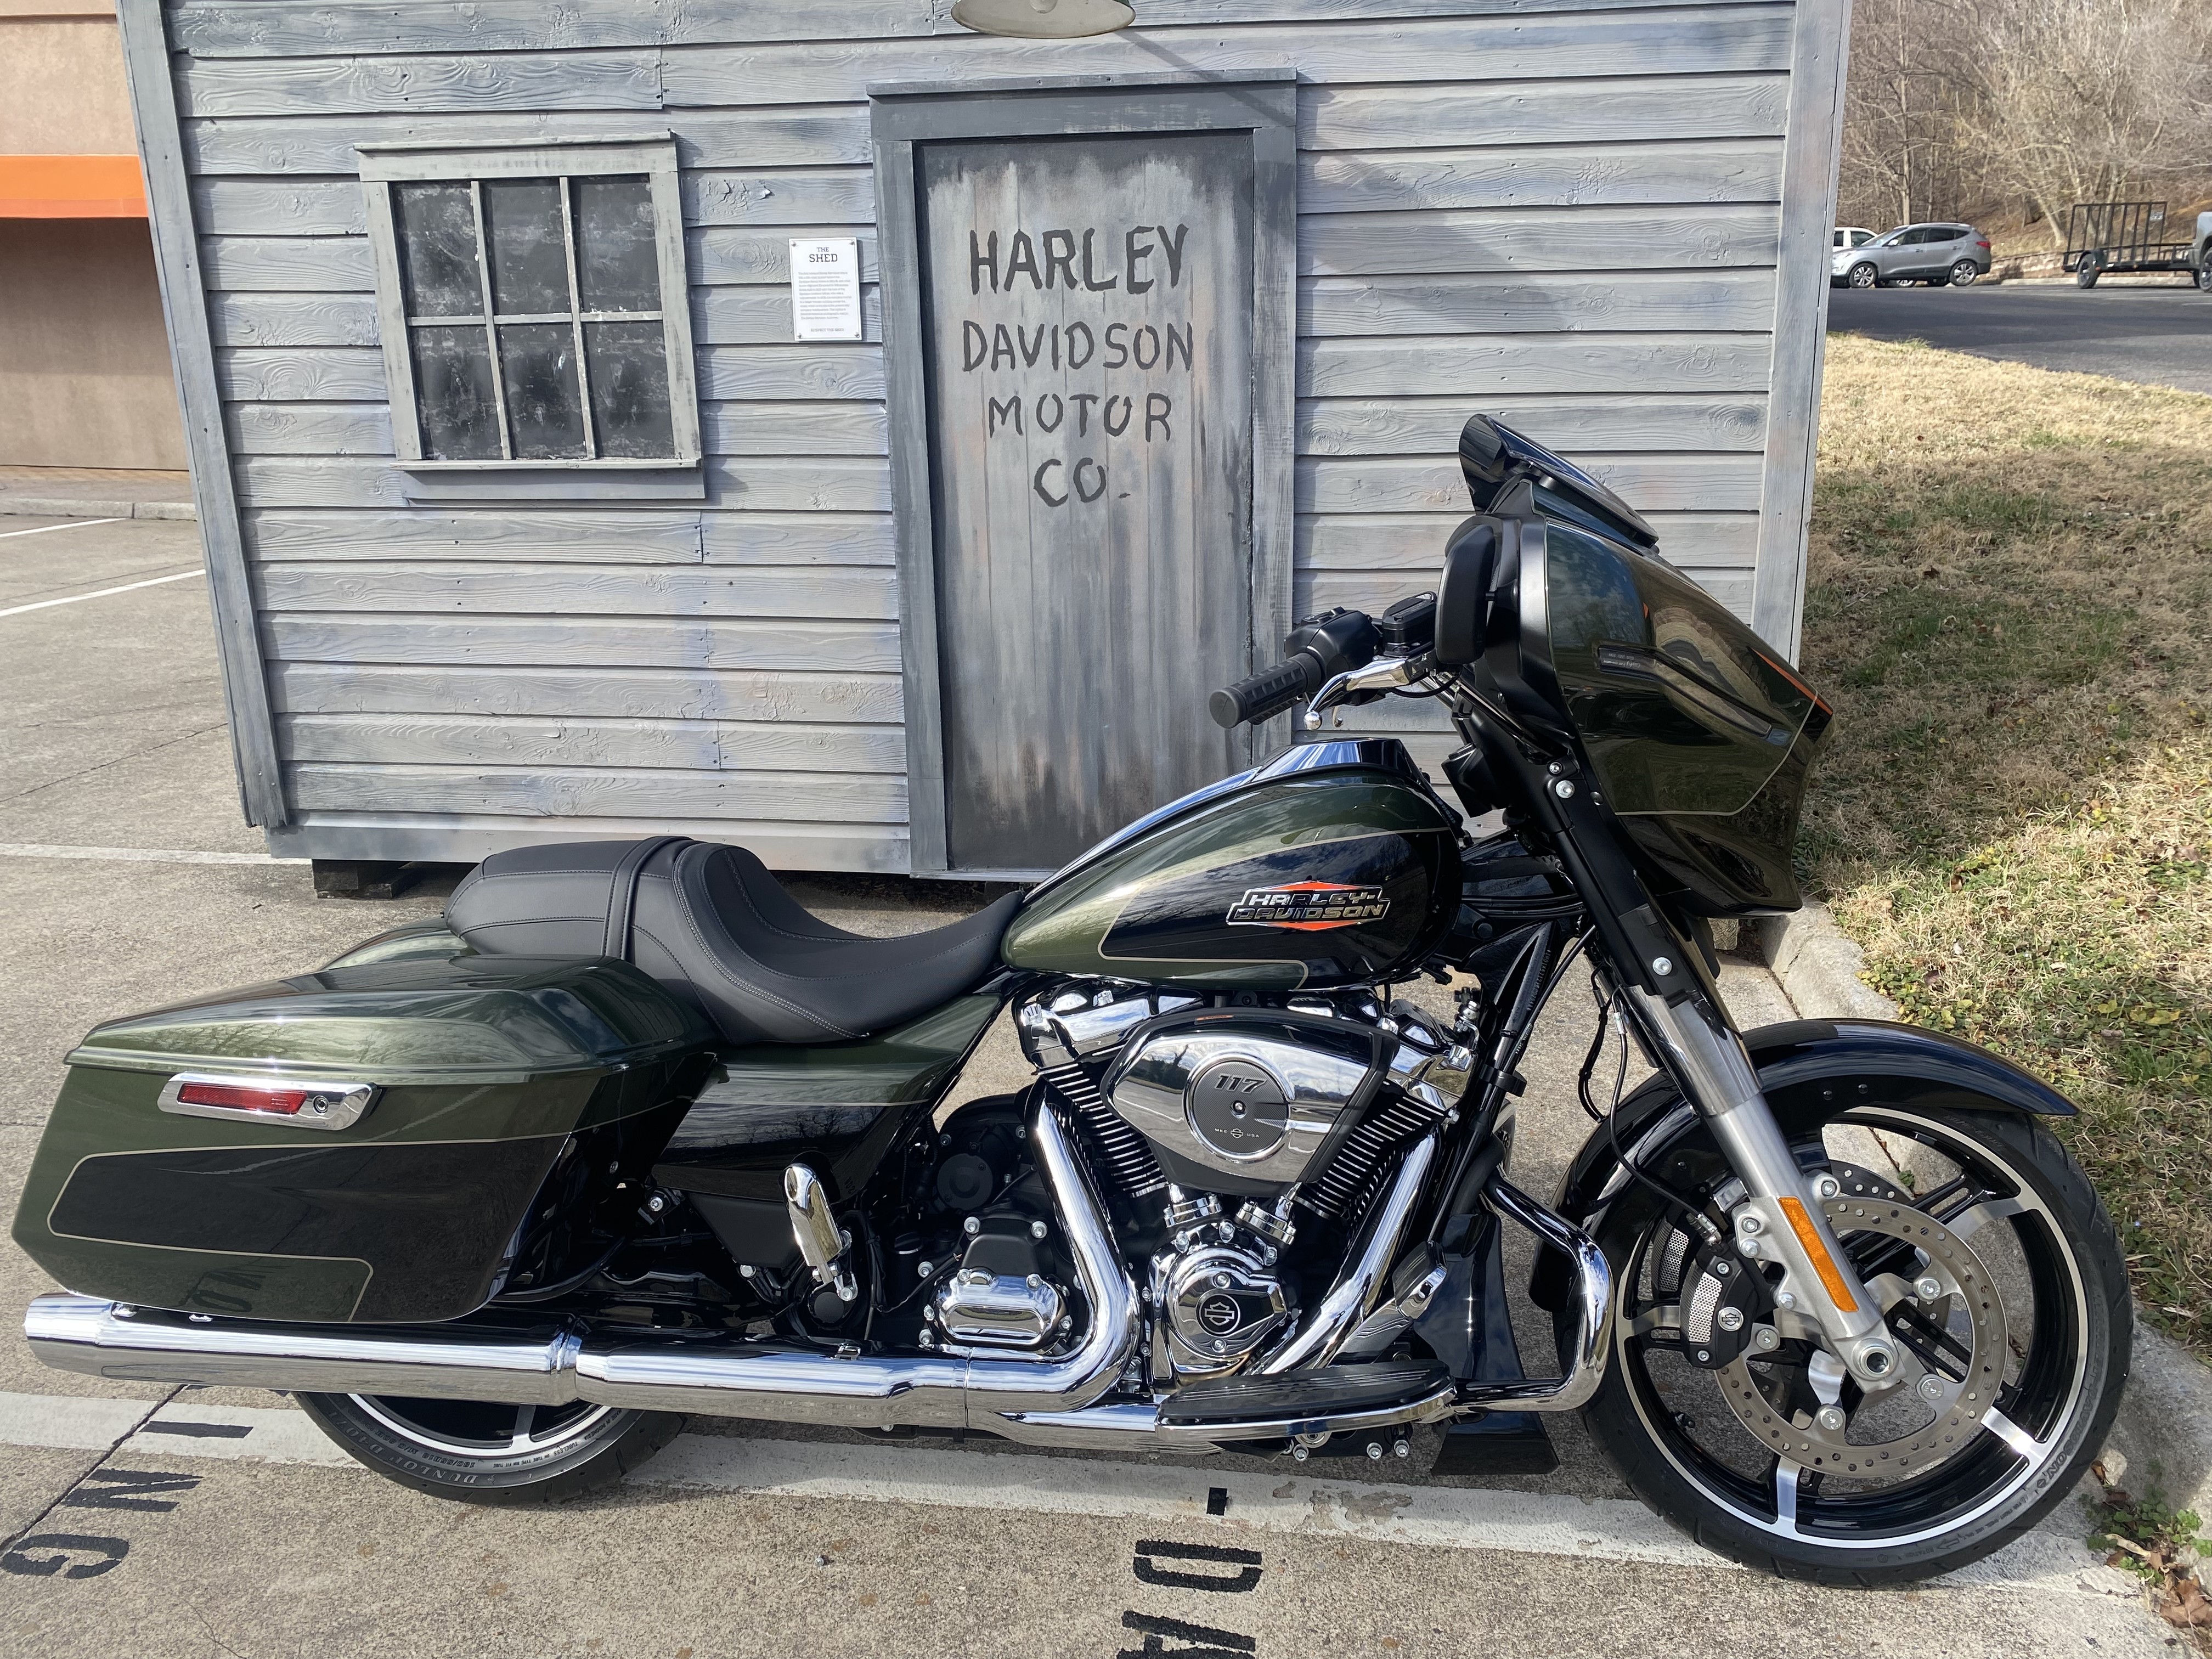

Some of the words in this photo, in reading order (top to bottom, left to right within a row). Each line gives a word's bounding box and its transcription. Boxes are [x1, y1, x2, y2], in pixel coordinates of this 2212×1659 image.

[809, 253, 838, 263] SHED
[970, 223, 1189, 295] HARLEY
[963, 320, 1193, 374] DAVIDSON
[989, 393, 1171, 442] MOTOR
[1033, 458, 1130, 507] CO.
[1248, 892, 1376, 906] HARLEY-
[1233, 904, 1384, 919] DAVIDSON
[1215, 1075, 1267, 1093] 117
[584, 1423, 606, 1441] INDONESIA
[398, 1442, 419, 1455] M/C
[553, 1442, 578, 1455] TUBELESS
[389, 1454, 478, 1483] DUNLOP
[0, 1385, 253, 1579] ING
